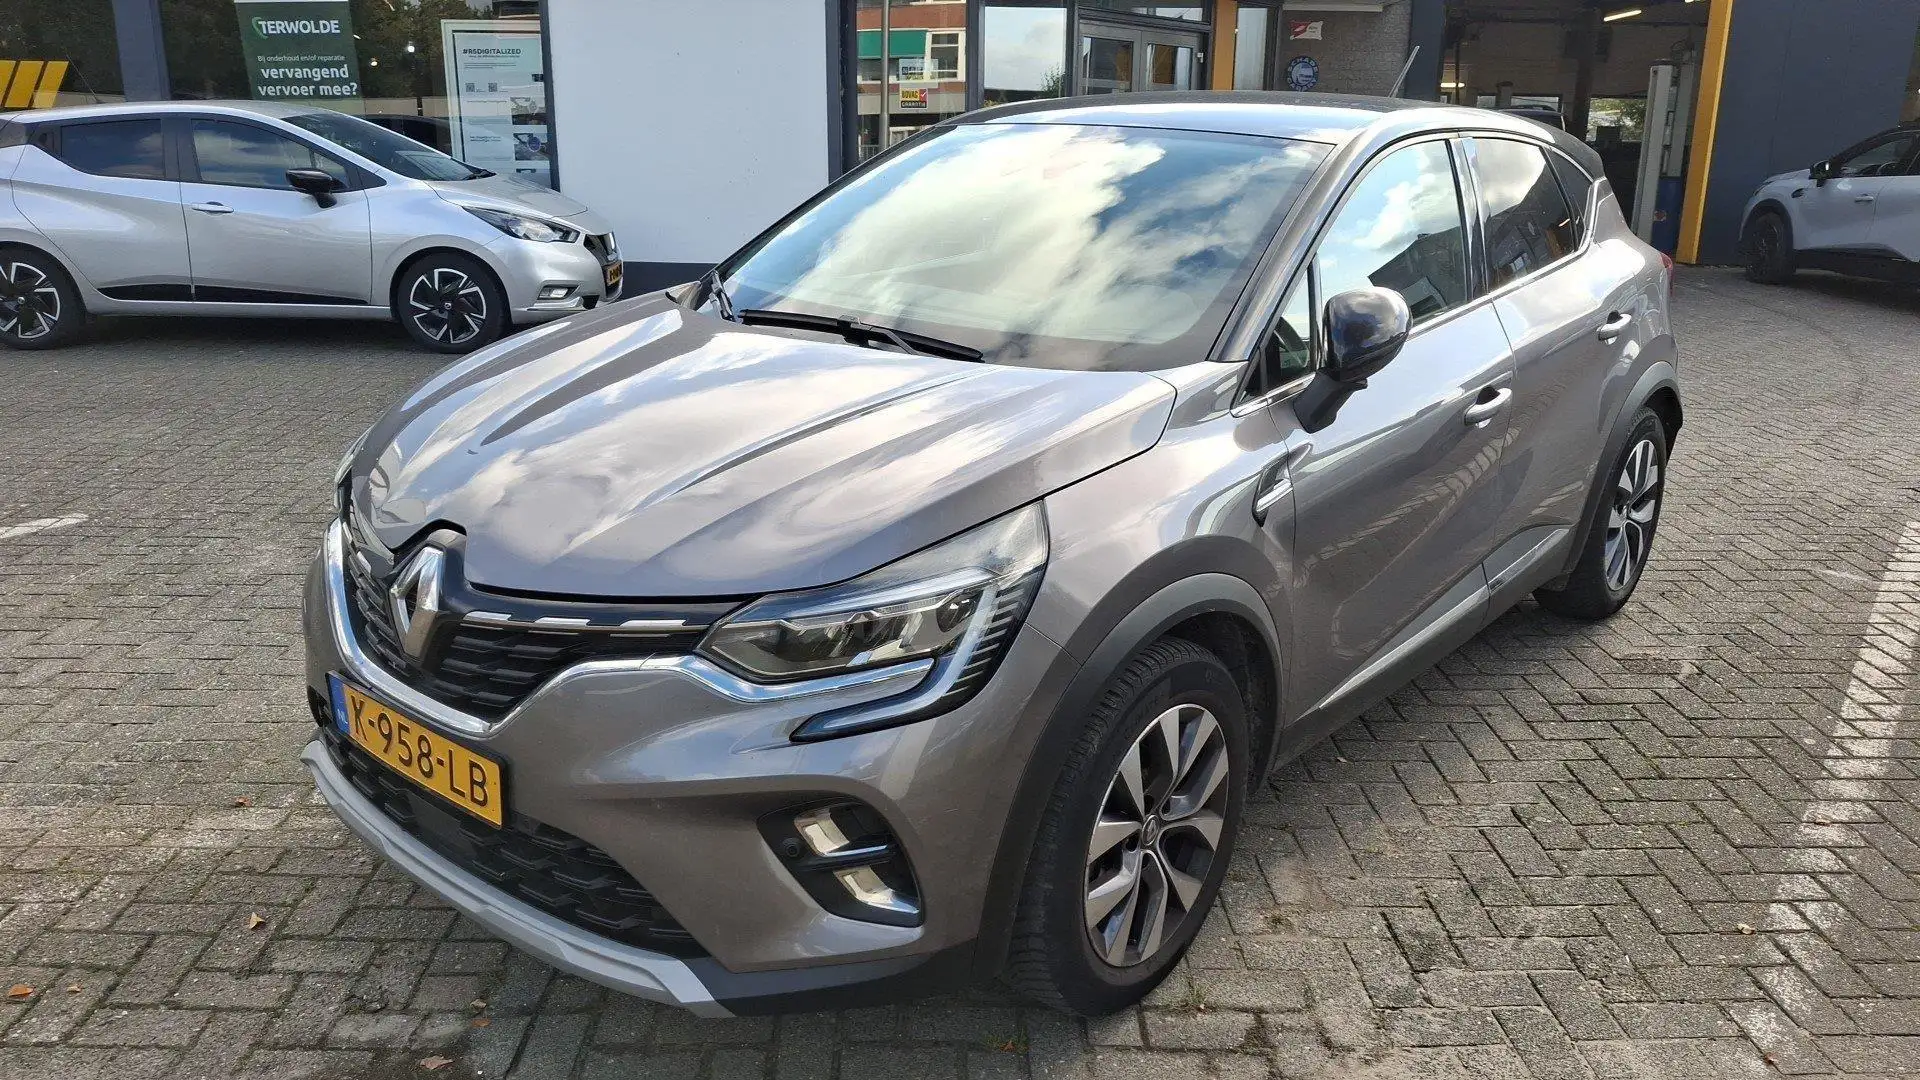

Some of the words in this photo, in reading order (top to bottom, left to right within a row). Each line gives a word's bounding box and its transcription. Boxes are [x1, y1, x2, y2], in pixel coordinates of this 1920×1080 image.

[258, 20, 341, 34] TERWOLDE
[261, 64, 349, 81] vervangend
[258, 84, 315, 96] vervoer
[320, 82, 357, 96] mee?
[351, 695, 489, 808] K-958-LB
